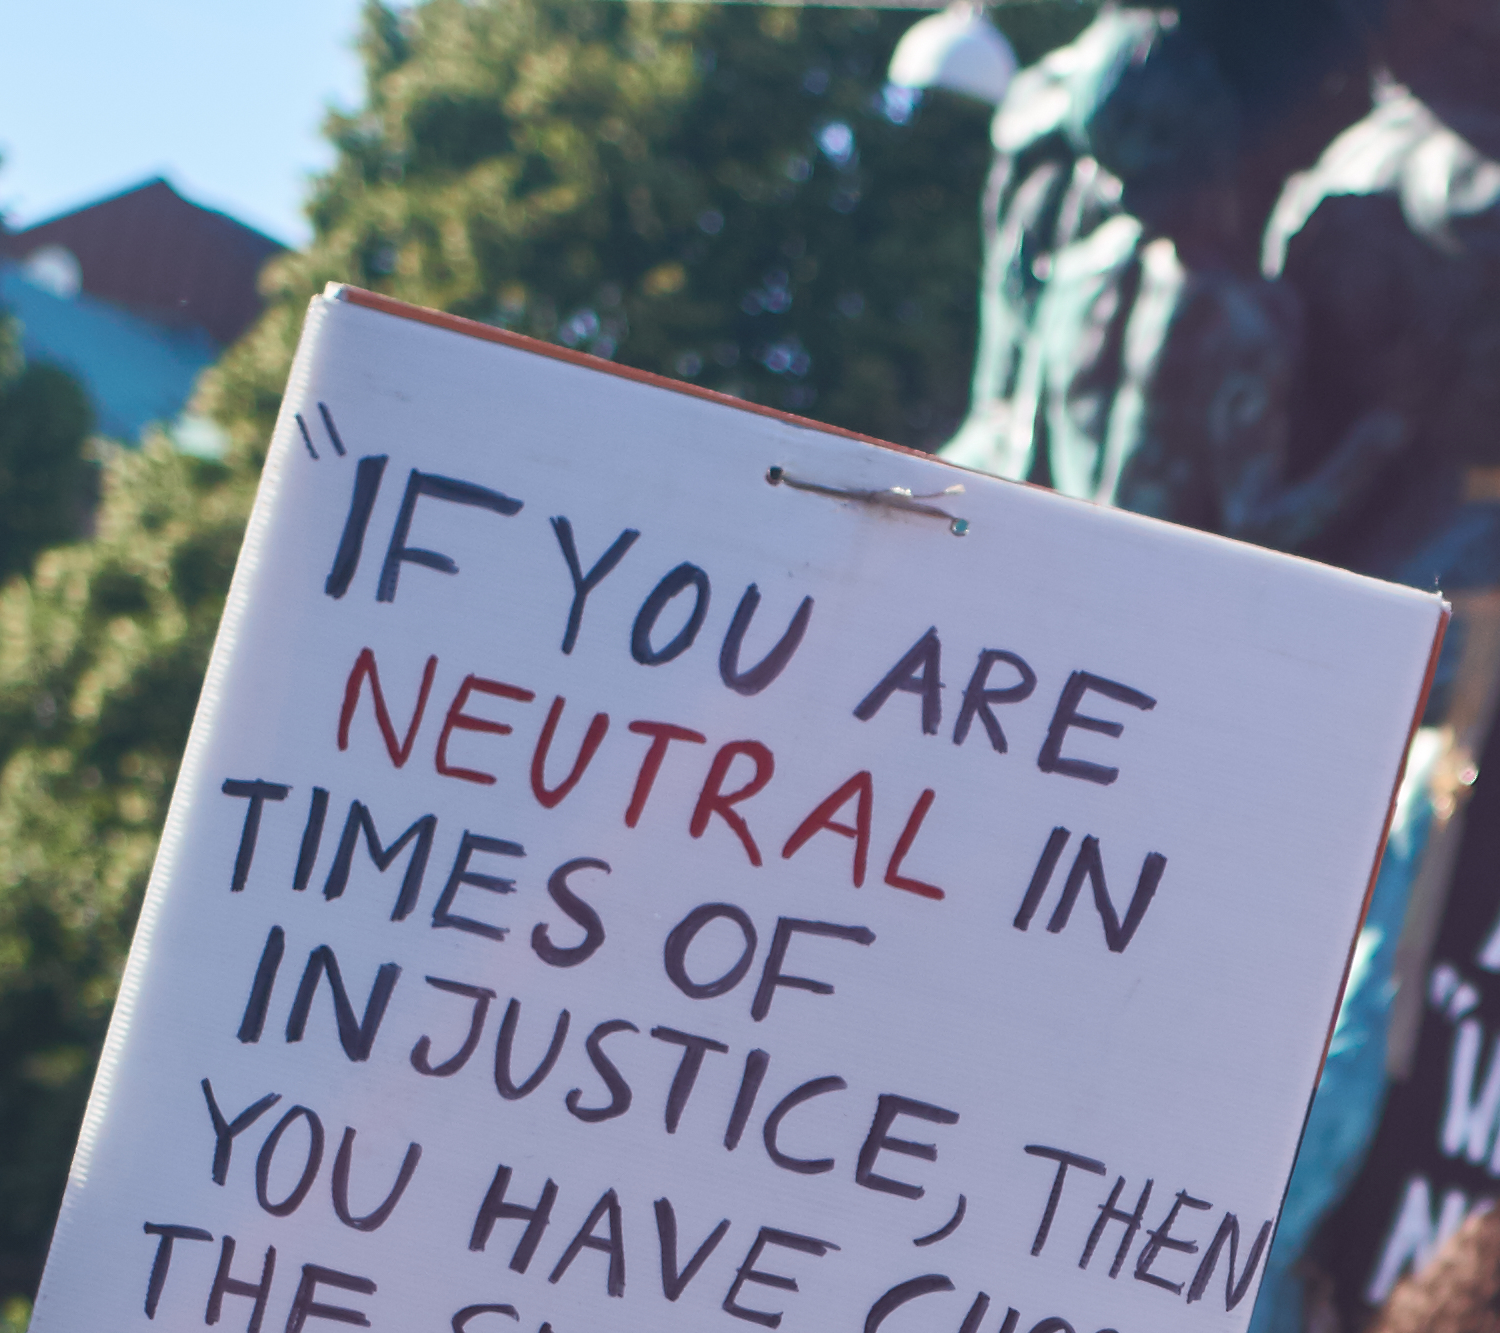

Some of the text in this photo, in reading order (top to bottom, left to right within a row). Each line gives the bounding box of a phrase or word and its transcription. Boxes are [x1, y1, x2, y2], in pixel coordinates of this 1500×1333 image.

[550, 515, 814, 696] YOU
[854, 626, 1156, 786] ARE
[221, 777, 875, 1020] TIMES OF
[337, 646, 1166, 954] NEUTRAL IN
[200, 1077, 422, 1231] YOU
[469, 1165, 840, 1329] HAVE
[237, 925, 1277, 1313] INJUSTICE, THEN
